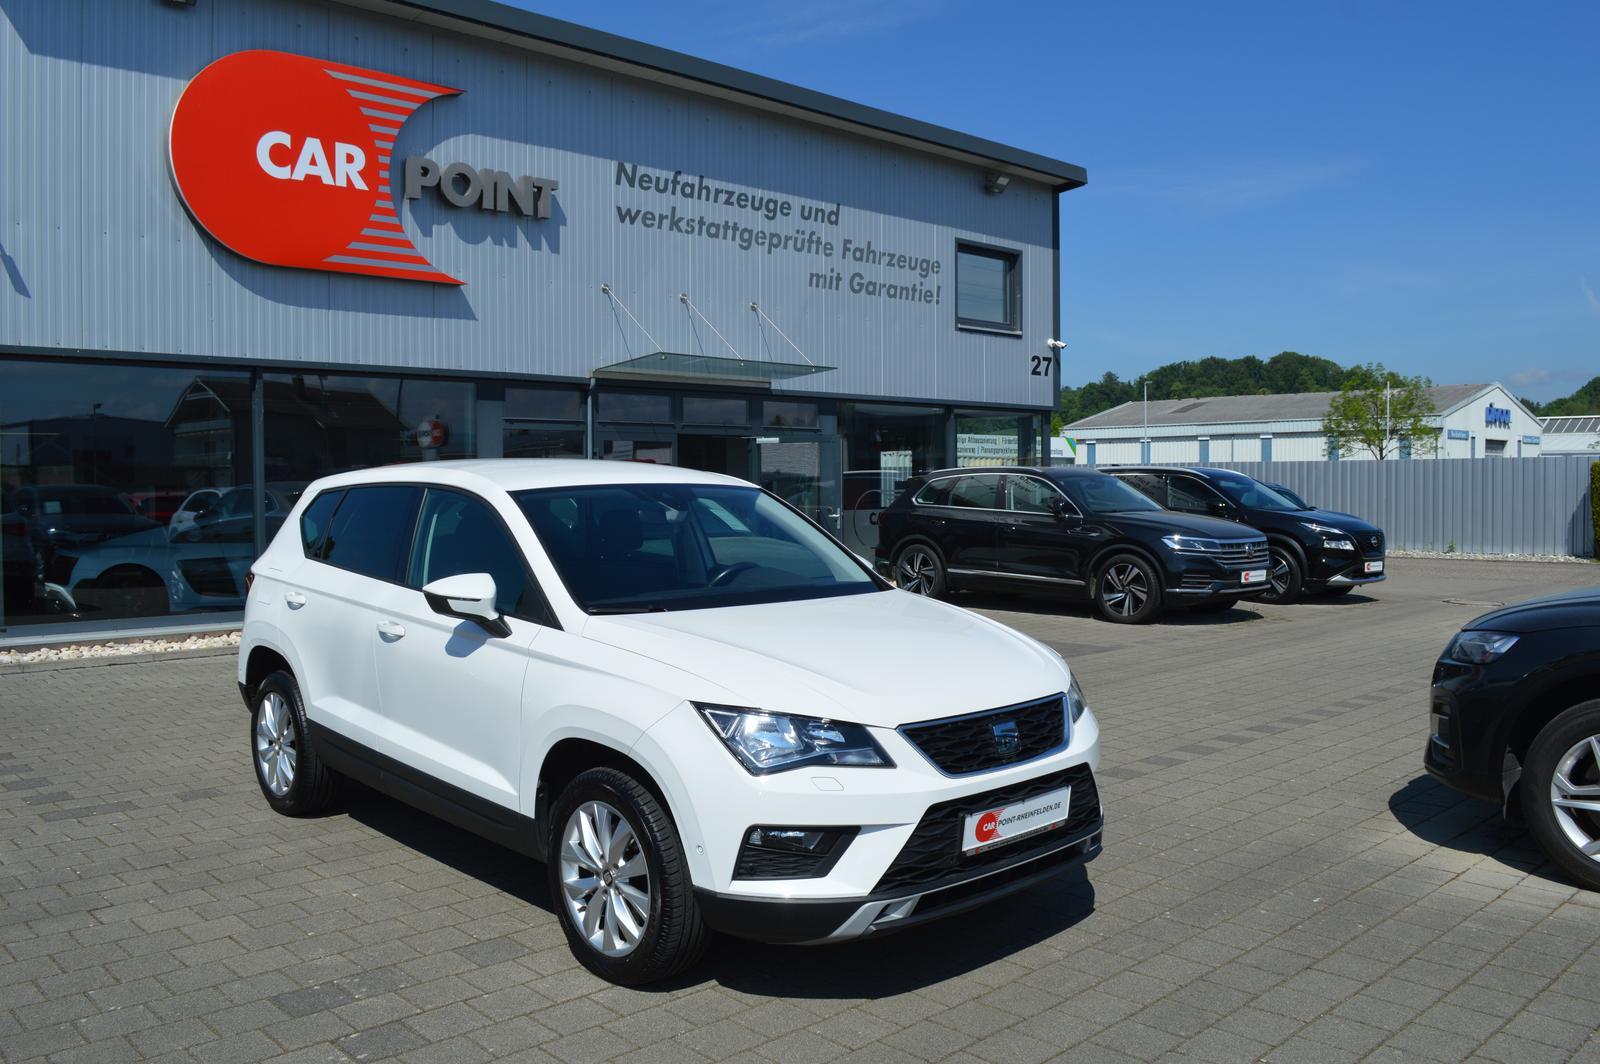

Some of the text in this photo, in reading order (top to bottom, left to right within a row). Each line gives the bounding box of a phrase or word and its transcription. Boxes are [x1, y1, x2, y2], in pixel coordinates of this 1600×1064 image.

[256, 130, 559, 219] CAR POINT
[615, 161, 841, 226] Neufahrzeuge und
[615, 205, 941, 279] werkstattgeprüfte Fahrzeuge
[808, 267, 941, 305] mit Garantie!
[1031, 355, 1052, 376] 27
[983, 802, 1061, 831] CAR POINT-RHEINFELDEN.DE
